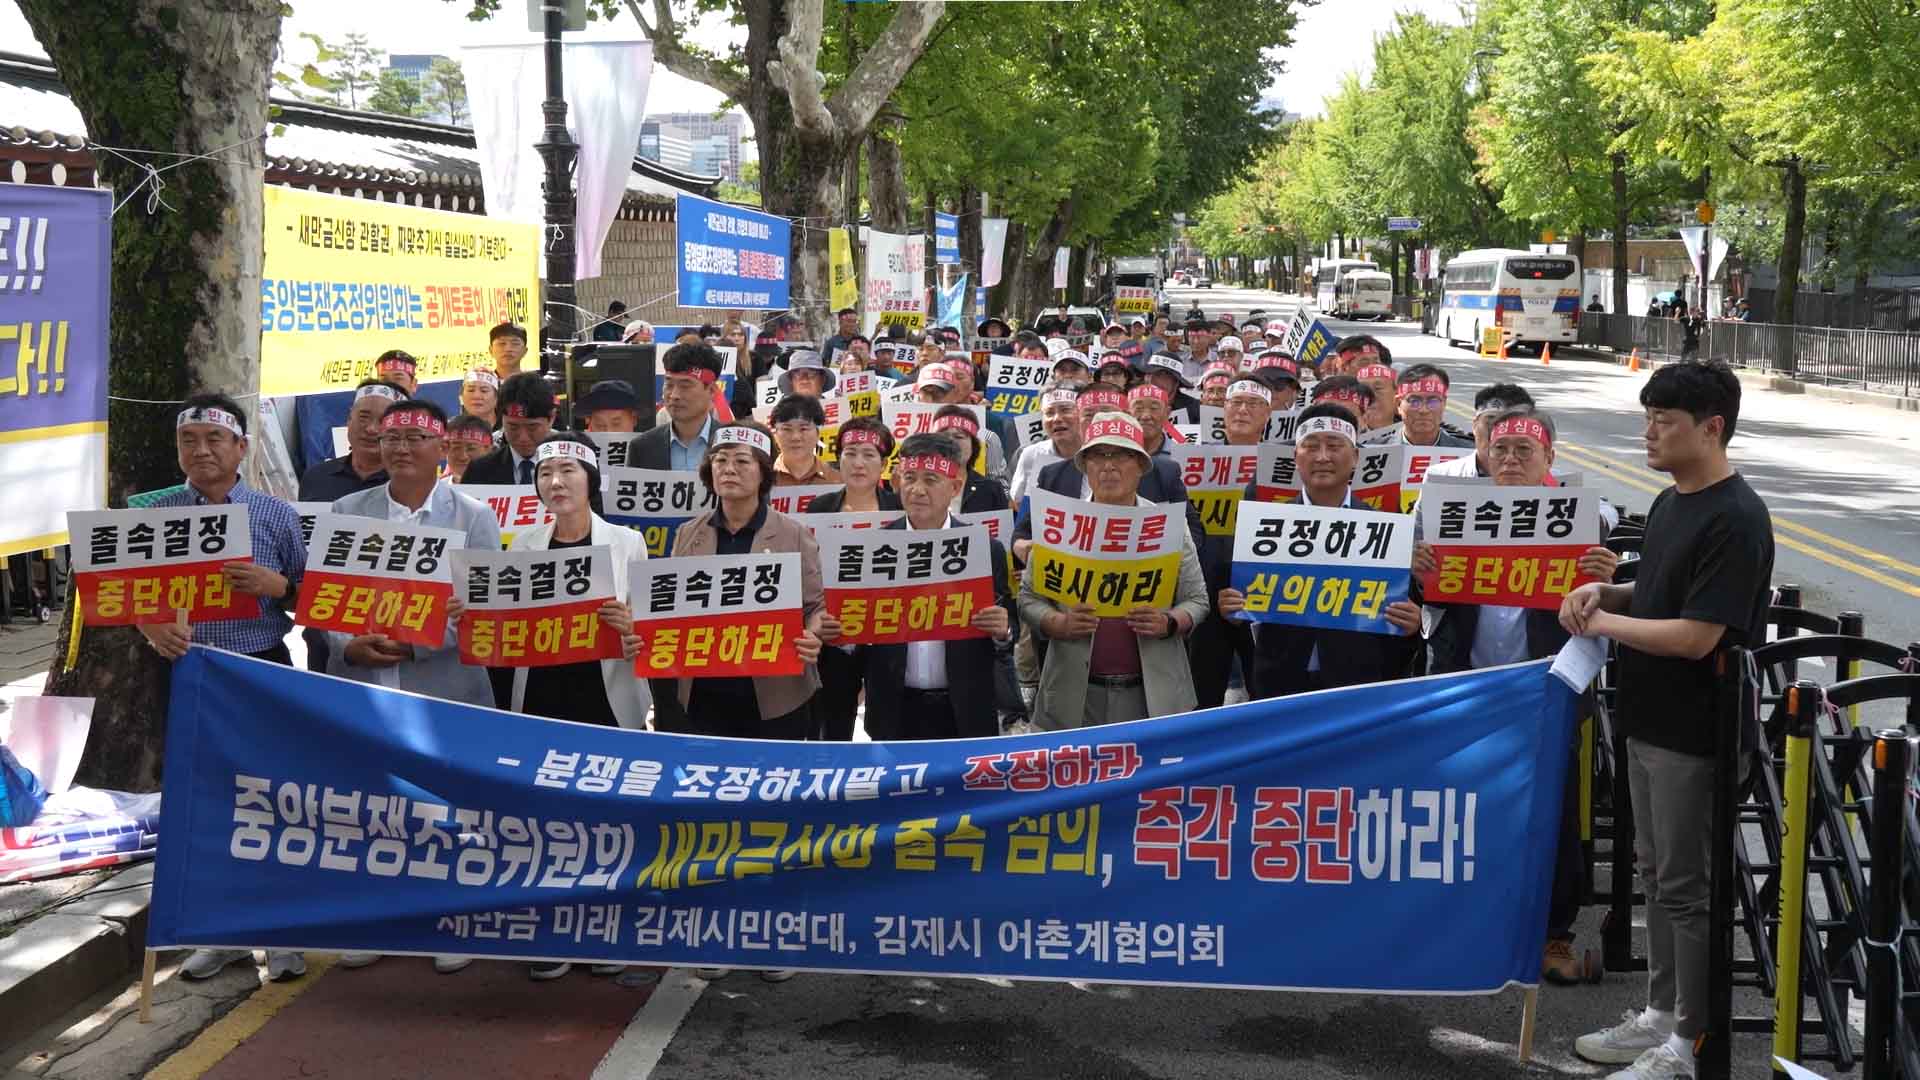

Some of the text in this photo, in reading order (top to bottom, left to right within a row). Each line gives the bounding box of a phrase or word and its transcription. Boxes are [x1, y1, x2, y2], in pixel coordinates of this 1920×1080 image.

[299, 214, 355, 250] 새만금신항
[261, 278, 423, 332] 중앙분쟁조정위원회는
[425, 285, 486, 329] 공개토론회
[997, 364, 1050, 387] 공정하
[720, 428, 764, 447] 속반대
[893, 411, 933, 440] 공개
[1085, 421, 1135, 441] 정심의
[1491, 421, 1544, 440] 정심의
[541, 442, 588, 460] 속반대
[1184, 455, 1258, 486] 공개토
[485, 495, 557, 529] 개토
[1043, 508, 1168, 553] 공개토론
[1438, 497, 1579, 539] 졸속결정
[90, 514, 229, 566] 졸속결정
[323, 529, 447, 575] 졸속결정
[837, 536, 970, 583] 졸속결정
[1252, 518, 1395, 560] 공정하게
[467, 555, 593, 604] 졸속결정
[650, 563, 783, 613] 졸속결정
[1044, 558, 1164, 607] 실시하라
[1243, 572, 1389, 620] 심의하라
[1438, 554, 1580, 598] 중단하라
[308, 581, 435, 632] 중단하라
[839, 591, 975, 637] 중단하라
[471, 612, 600, 659] 중단하라
[649, 623, 784, 670] 중단하라
[533, 749, 663, 797] 분쟁을
[962, 743, 1143, 793] 조정하라
[230, 773, 636, 890] 중앙분쟁조정위원회
[1006, 804, 1113, 889] 심의,
[1133, 784, 1237, 881] 즉각
[1250, 786, 1478, 884] 중단하라!
[552, 903, 622, 945] 미래
[633, 904, 857, 956] 김제시민연대,
[873, 914, 982, 959] 김제시
[998, 918, 1225, 968] 어촌계협의회
